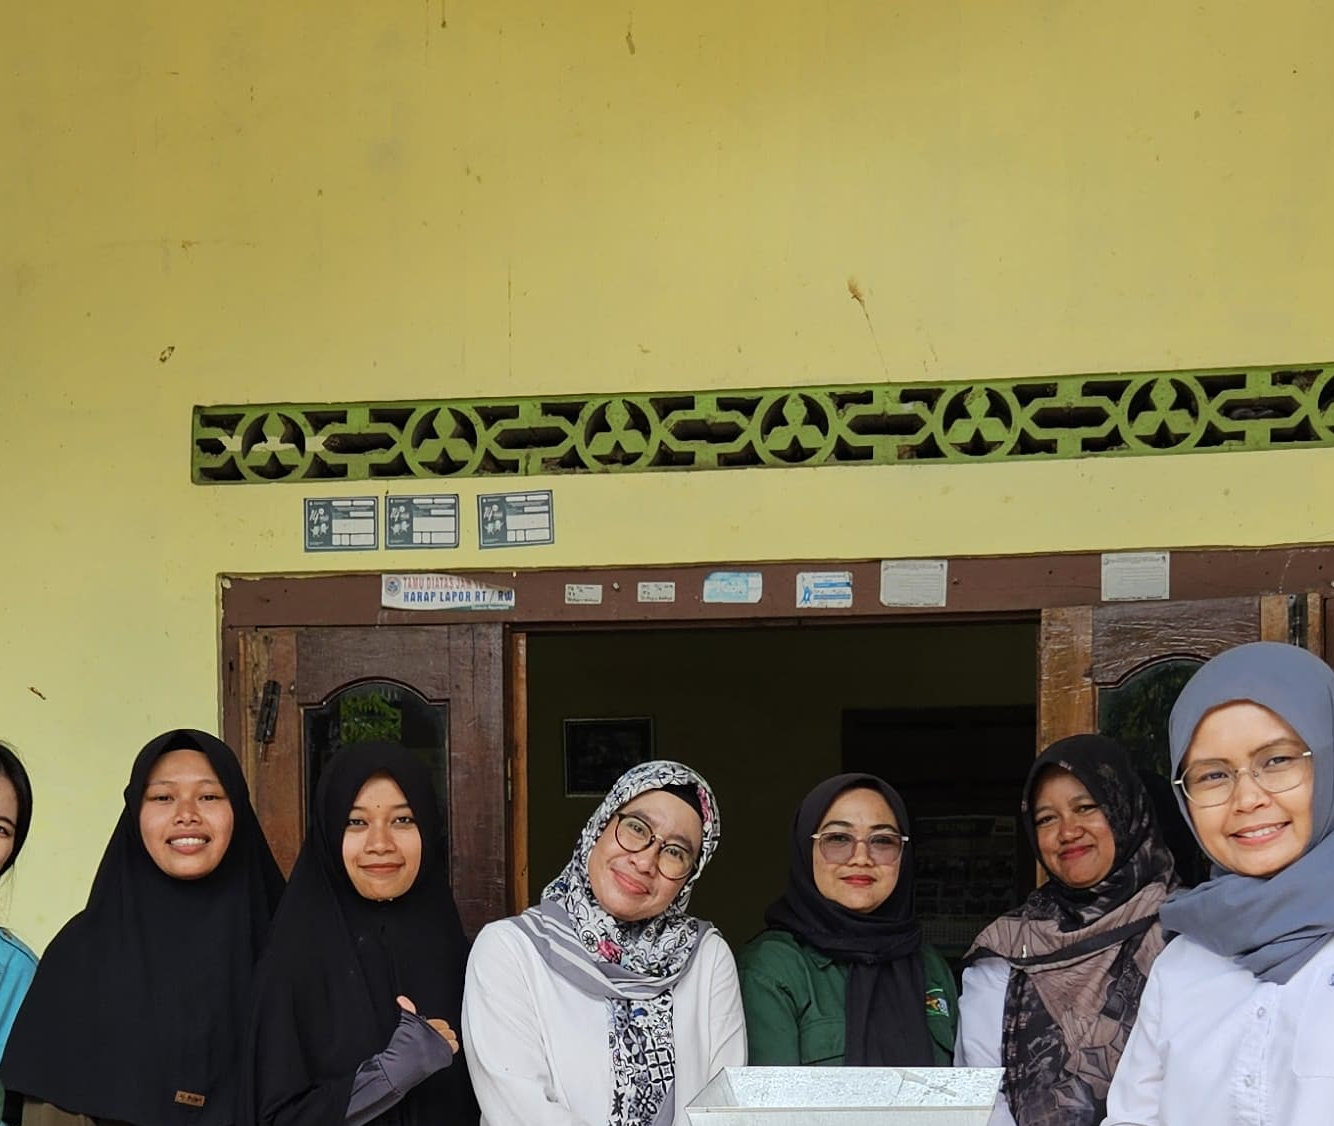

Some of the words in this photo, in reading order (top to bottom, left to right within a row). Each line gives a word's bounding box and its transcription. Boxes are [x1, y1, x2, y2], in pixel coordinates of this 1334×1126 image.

[403, 577, 423, 589] TAMU
[403, 591, 436, 603] HARAP
[439, 591, 471, 602] LAPOR
[475, 591, 486, 602] RT
[498, 590, 513, 601] RW
